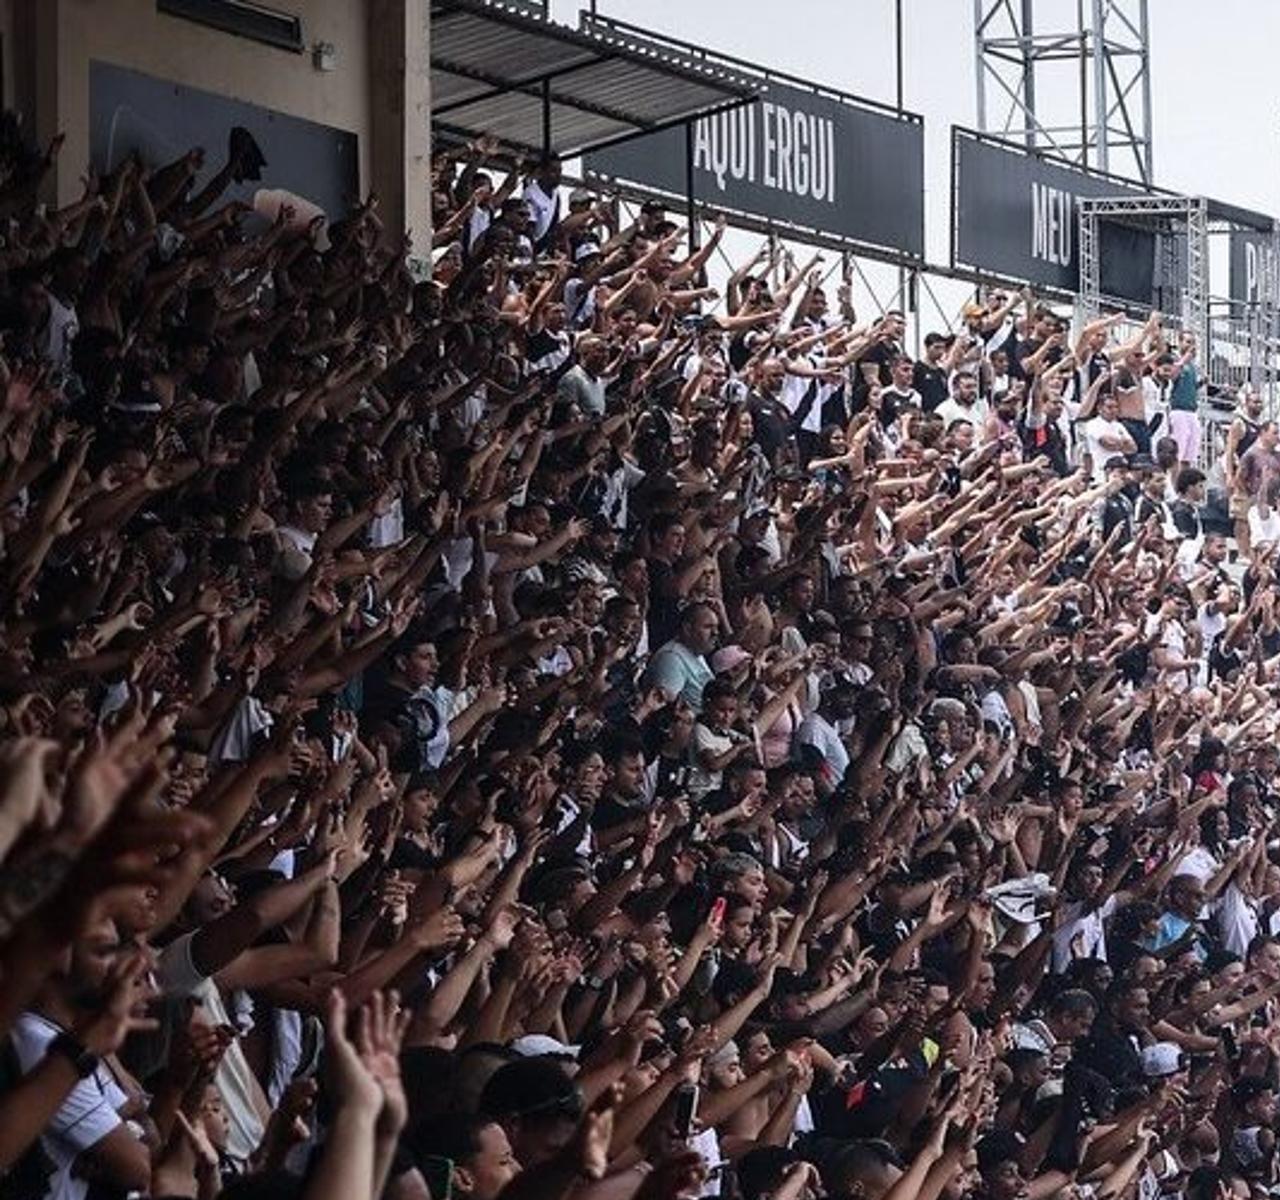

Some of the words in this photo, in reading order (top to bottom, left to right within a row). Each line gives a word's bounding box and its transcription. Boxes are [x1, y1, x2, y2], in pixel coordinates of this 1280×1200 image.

[694, 103, 755, 191] AQUI
[763, 102, 834, 202] ERGUI
[1032, 182, 1072, 267] MEU
